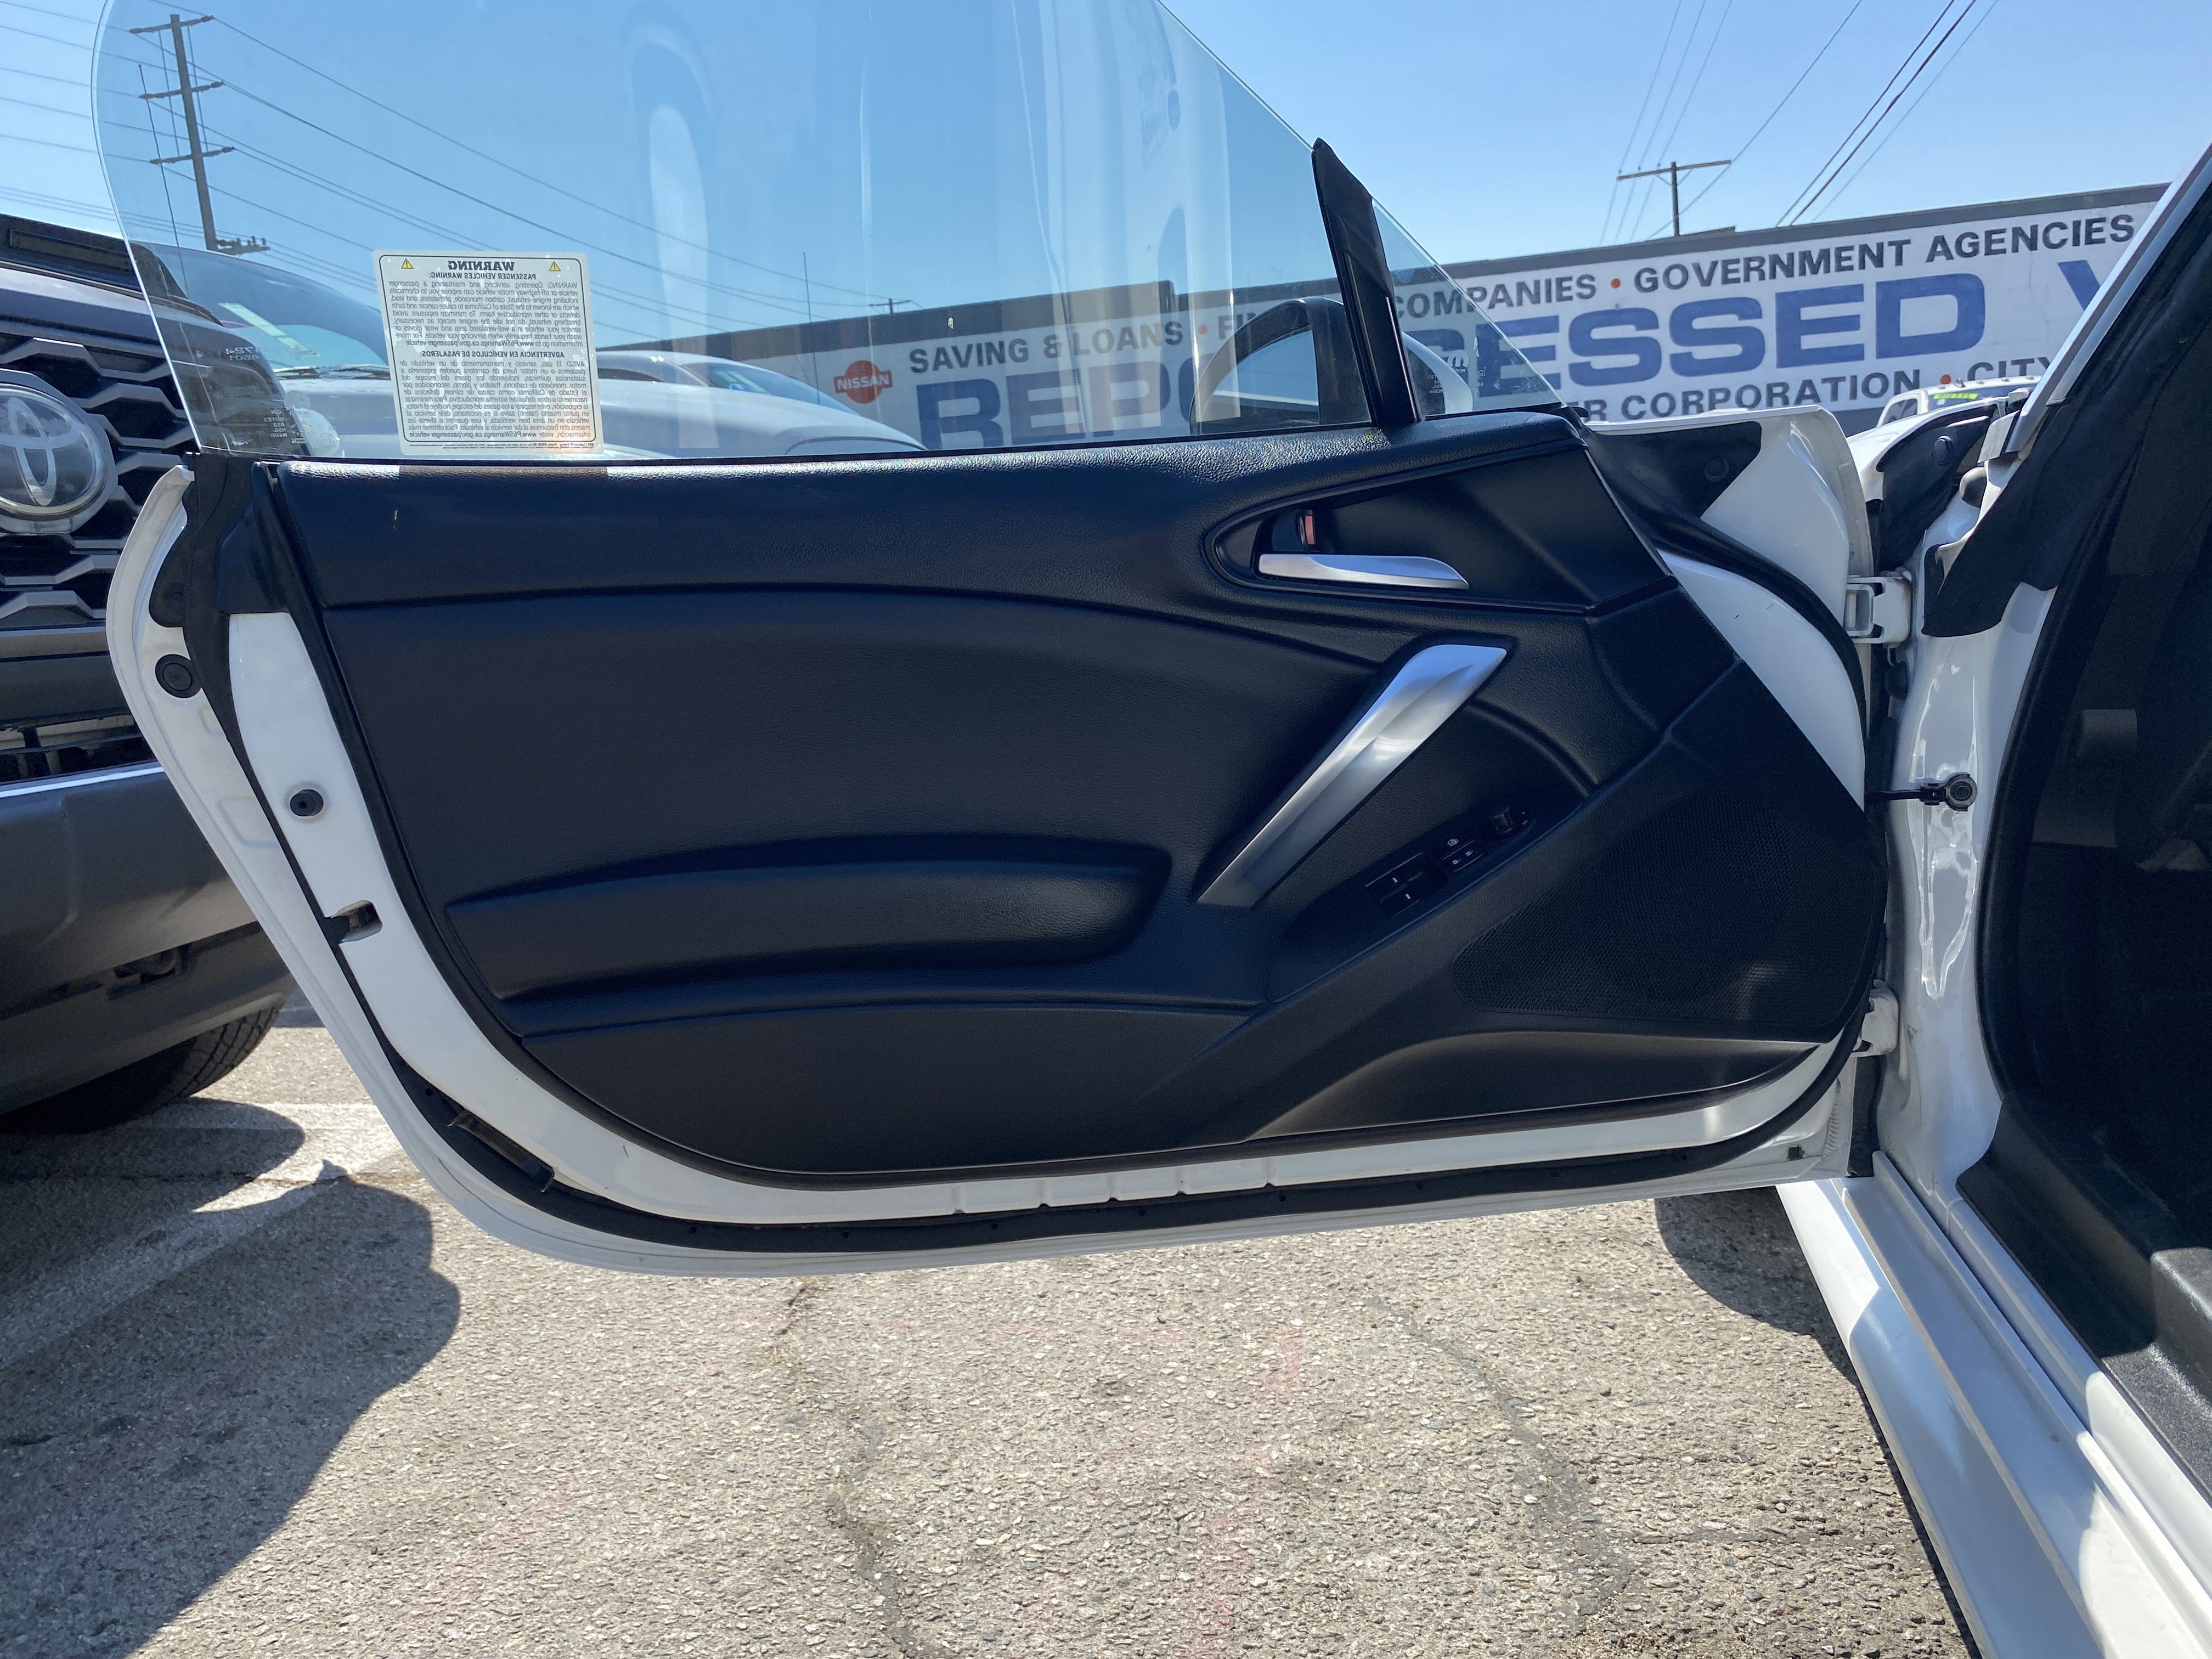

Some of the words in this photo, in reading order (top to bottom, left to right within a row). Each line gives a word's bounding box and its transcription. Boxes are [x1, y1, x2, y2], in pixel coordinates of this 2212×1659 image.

[909, 338, 1029, 374] SAVING
[1043, 334, 1062, 359] &
[1074, 320, 1183, 356] LOANS
[1634, 239, 1911, 293] GOVERNMENT
[1925, 214, 2135, 263] AGENCIES
[837, 375, 889, 390] NISSAN
[1621, 369, 1920, 420] CORPORATION
